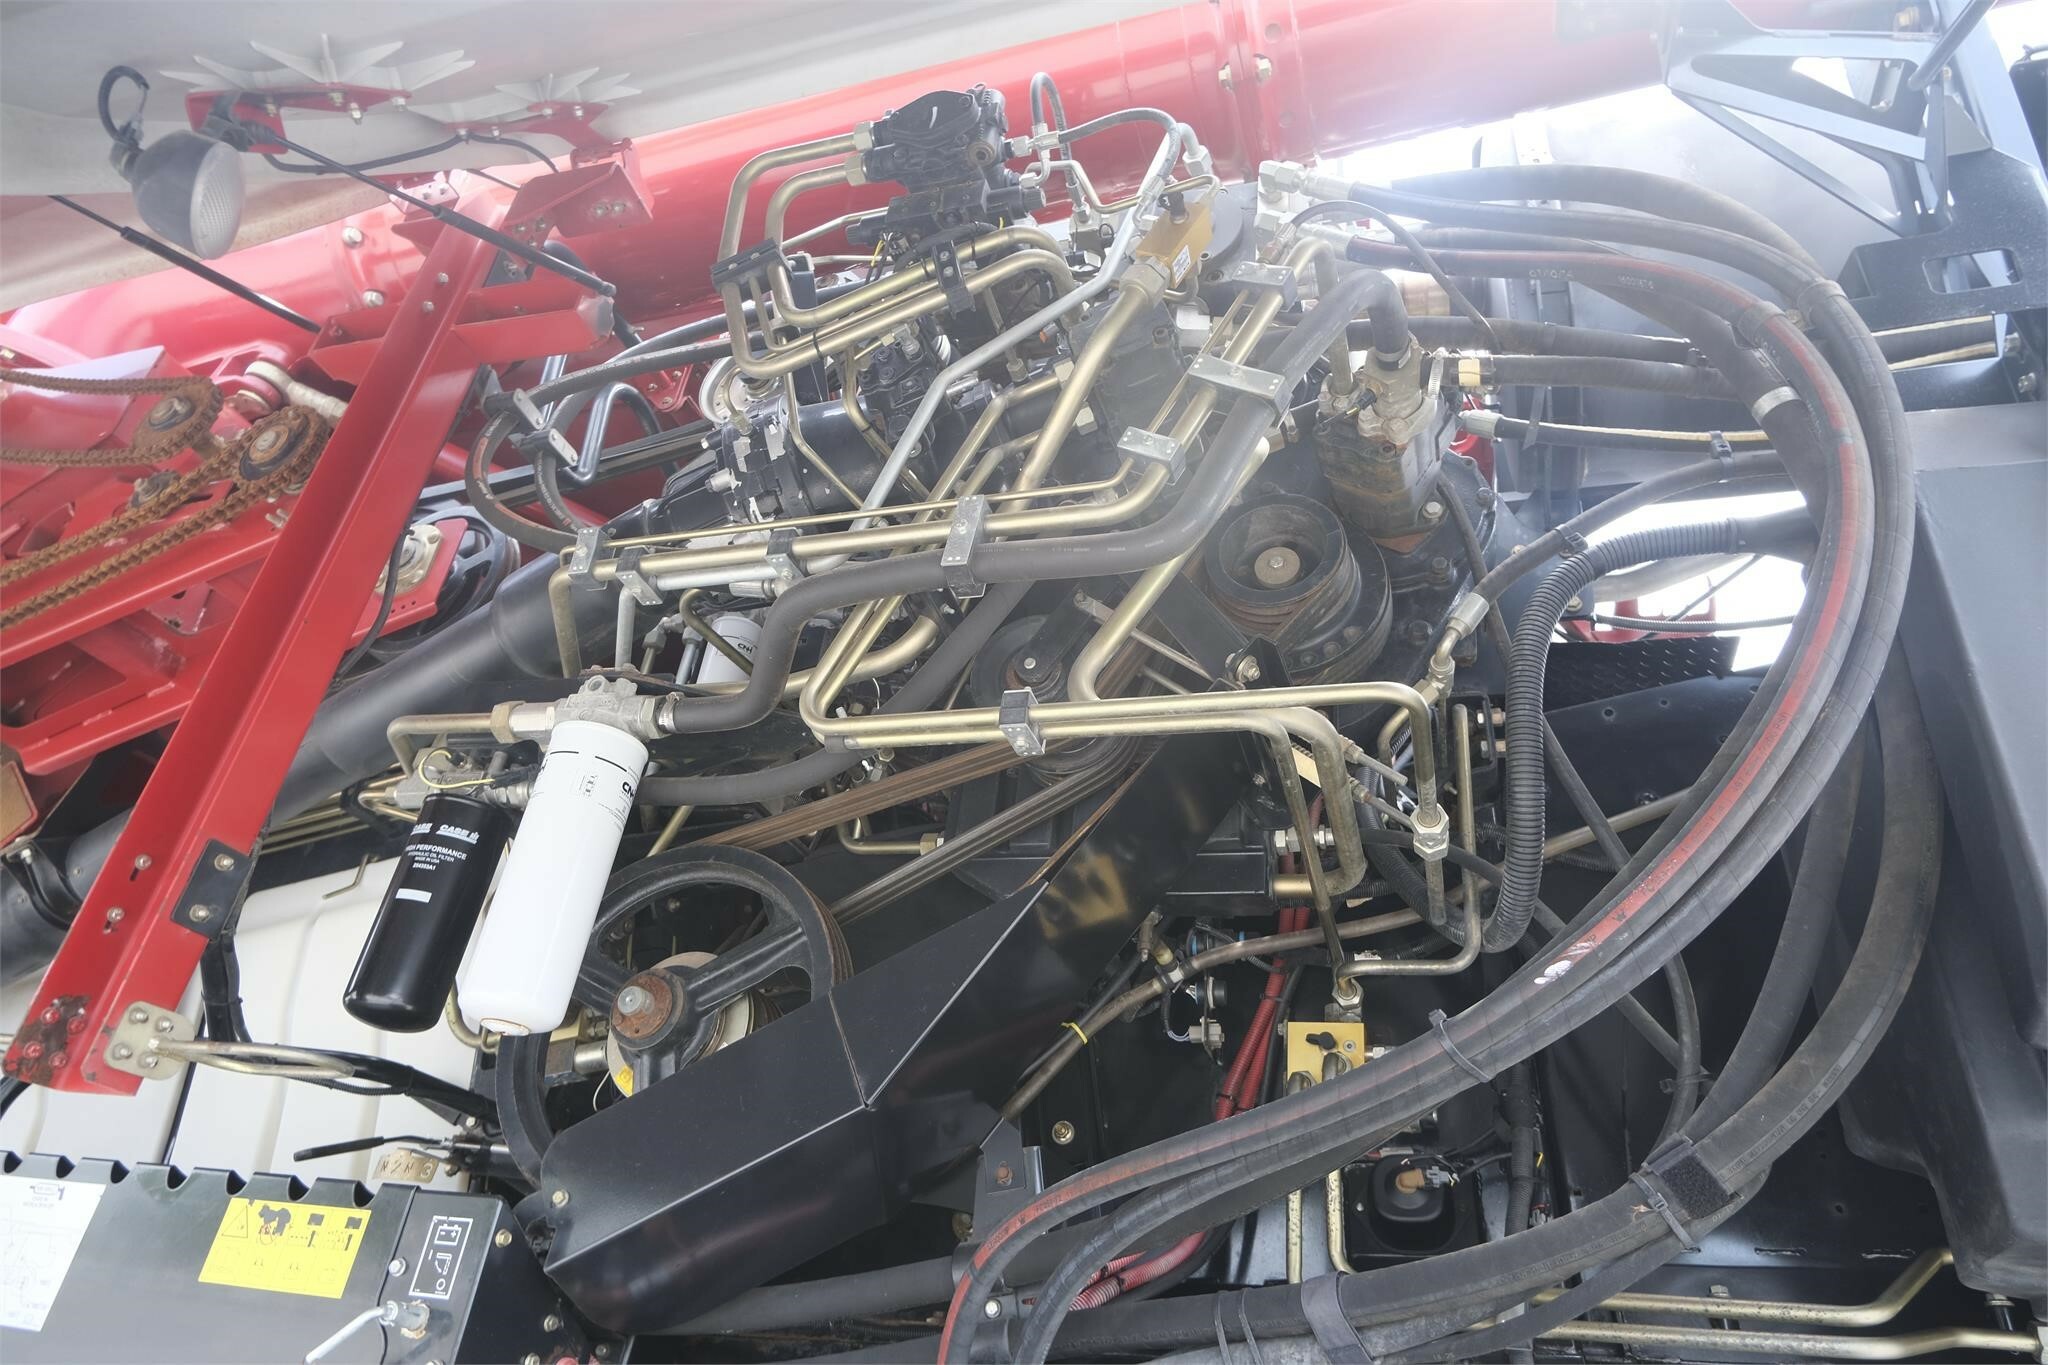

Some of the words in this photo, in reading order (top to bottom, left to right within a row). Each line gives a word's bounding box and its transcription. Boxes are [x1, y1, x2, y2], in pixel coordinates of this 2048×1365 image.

[440, 824, 470, 837] CASE
[416, 844, 468, 861] PERFORMANCE
[437, 853, 455, 863] FILTER
[420, 1161, 434, 1177] 3
